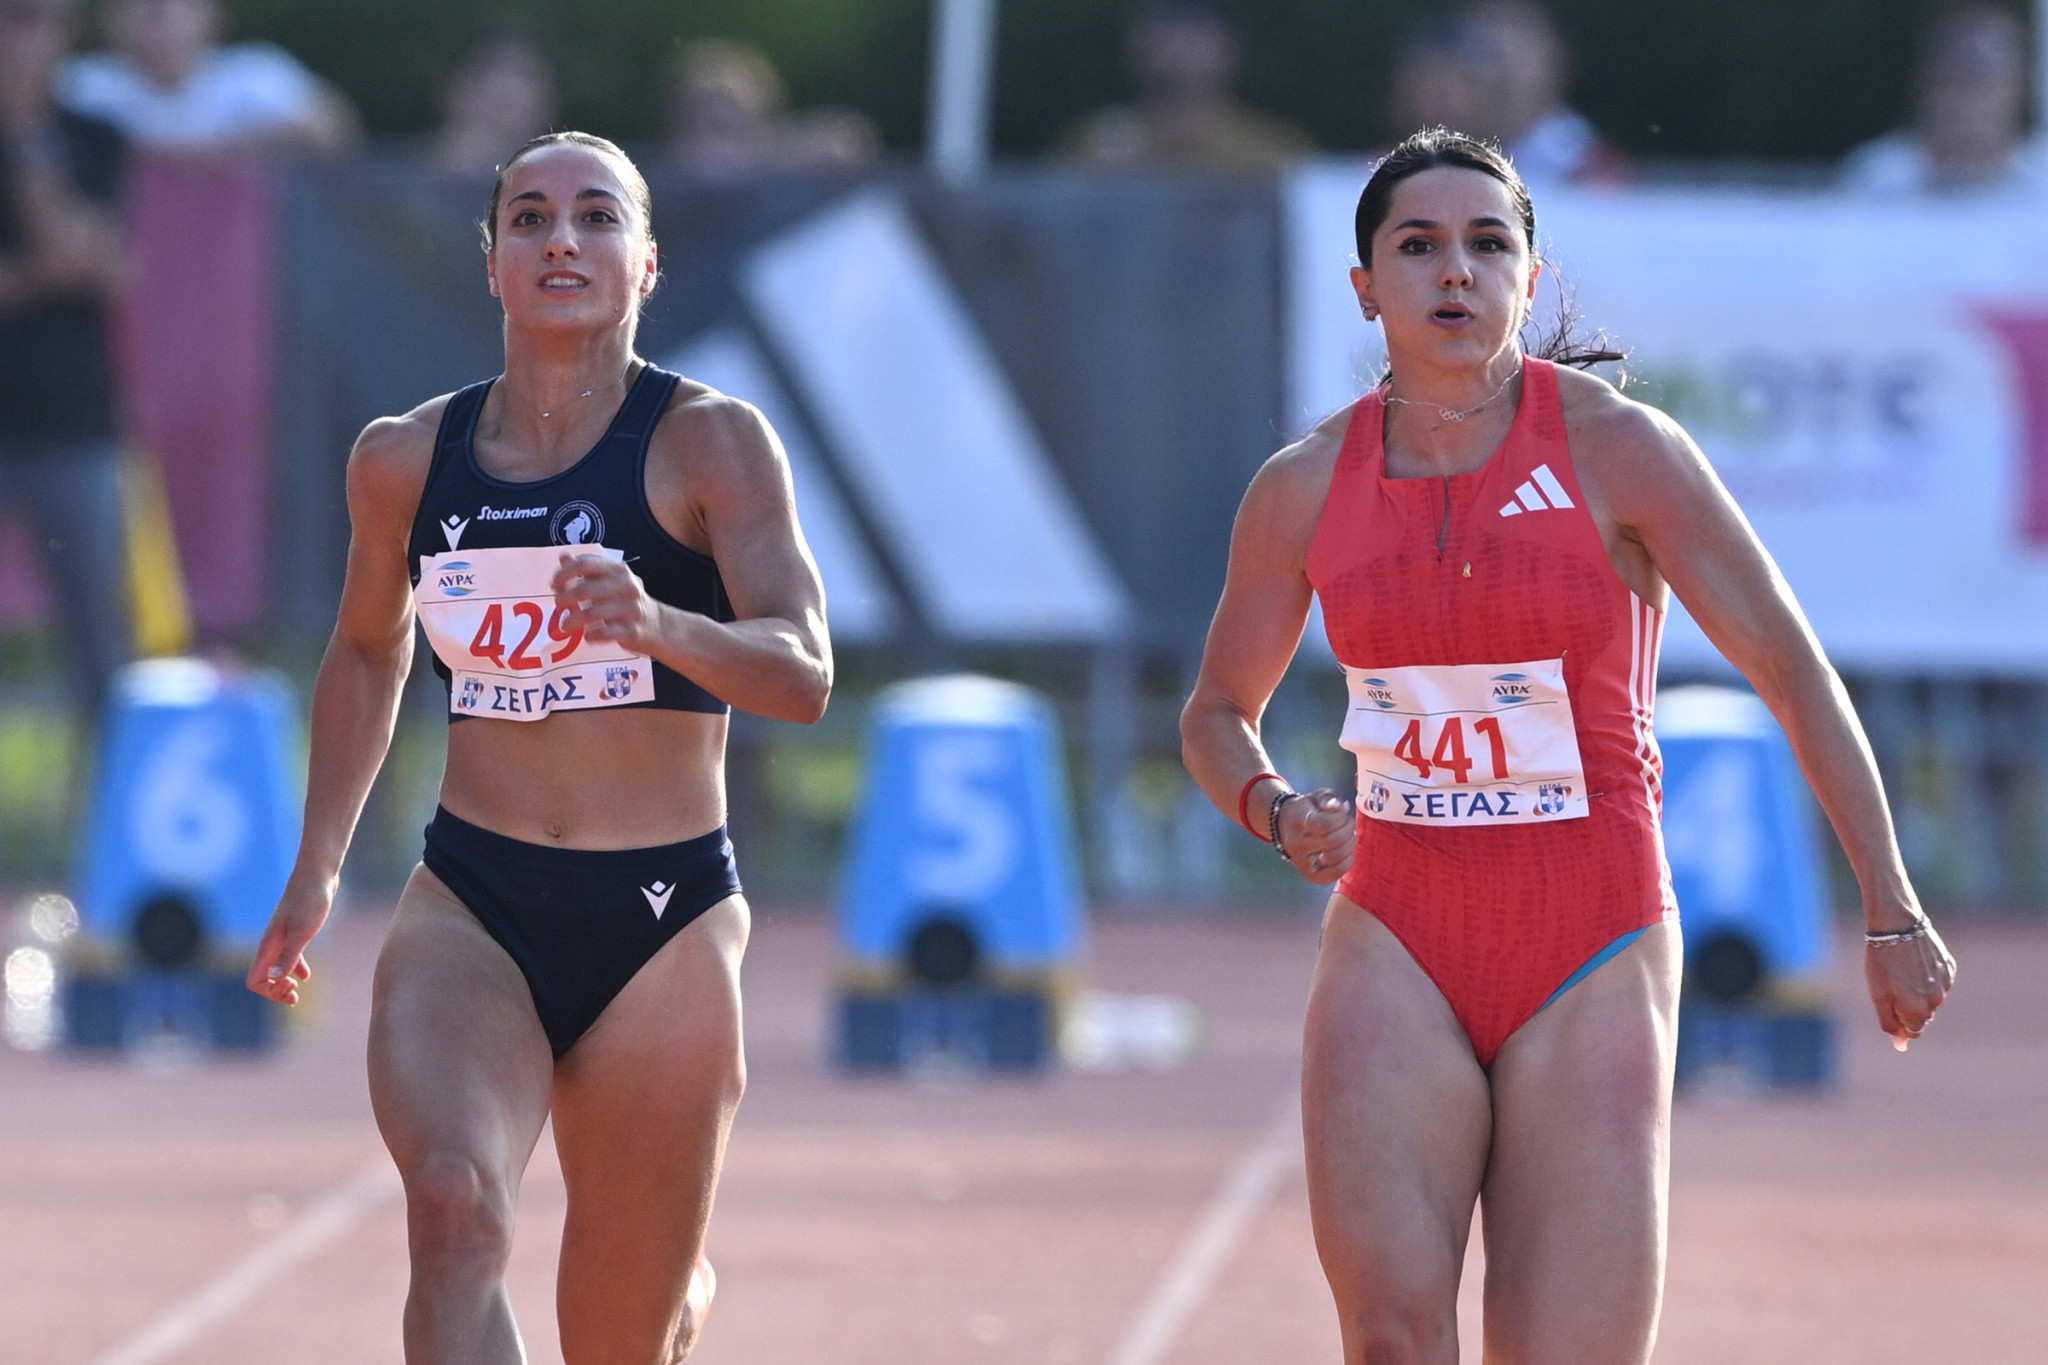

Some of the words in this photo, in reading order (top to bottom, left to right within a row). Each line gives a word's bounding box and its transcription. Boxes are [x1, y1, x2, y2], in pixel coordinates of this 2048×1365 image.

[477, 505, 548, 520] Stoiximan
[469, 601, 585, 670] 429
[491, 675, 586, 713] ΣΕΓΑΣ
[1394, 716, 1510, 783] 441
[132, 715, 248, 880] 6
[904, 733, 1020, 898] 5
[1401, 791, 1519, 818] ΣΕΓΑΣ
[1661, 742, 1757, 904] 4
